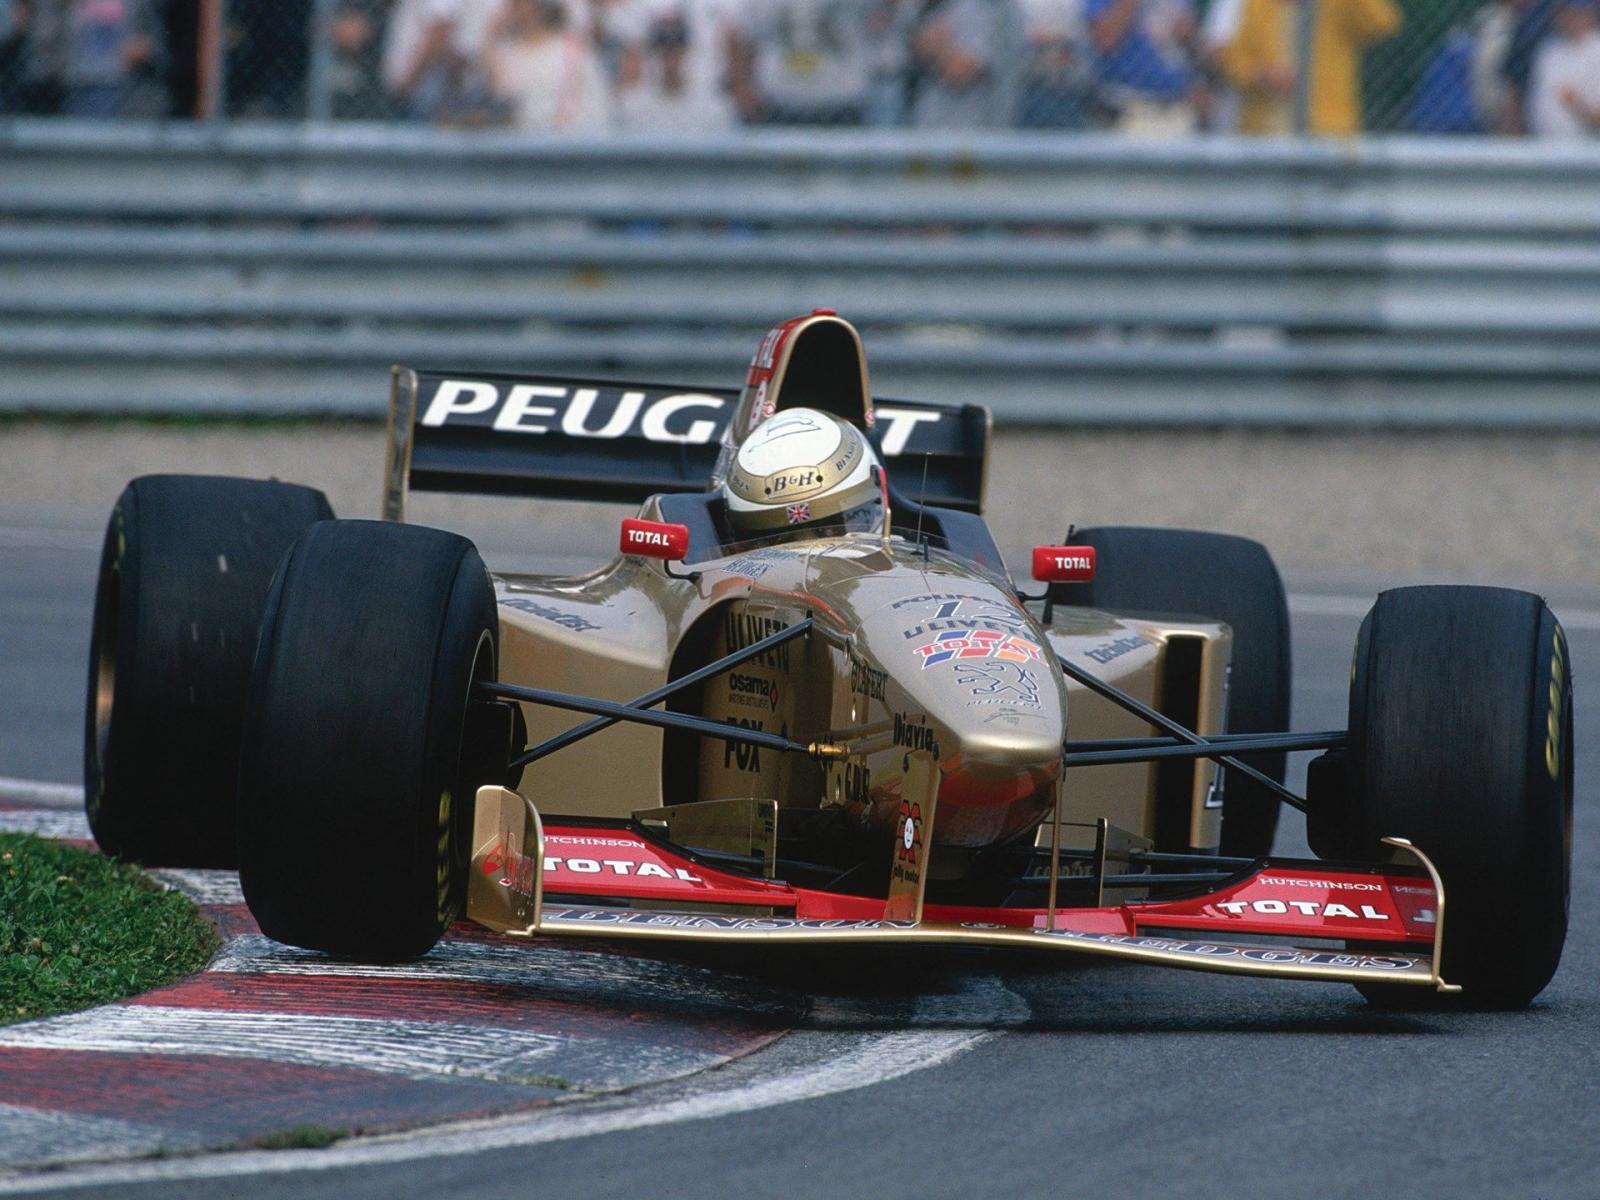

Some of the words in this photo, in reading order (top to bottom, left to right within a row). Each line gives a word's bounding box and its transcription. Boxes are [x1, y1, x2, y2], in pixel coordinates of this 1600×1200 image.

[421, 379, 941, 455] PEUGT
[628, 530, 670, 546] TOTAL
[1055, 557, 1091, 569] TOTAL
[729, 672, 770, 696] osama
[1260, 878, 1383, 892] HUTCHINSON
[1216, 899, 1390, 920] TOTAL
